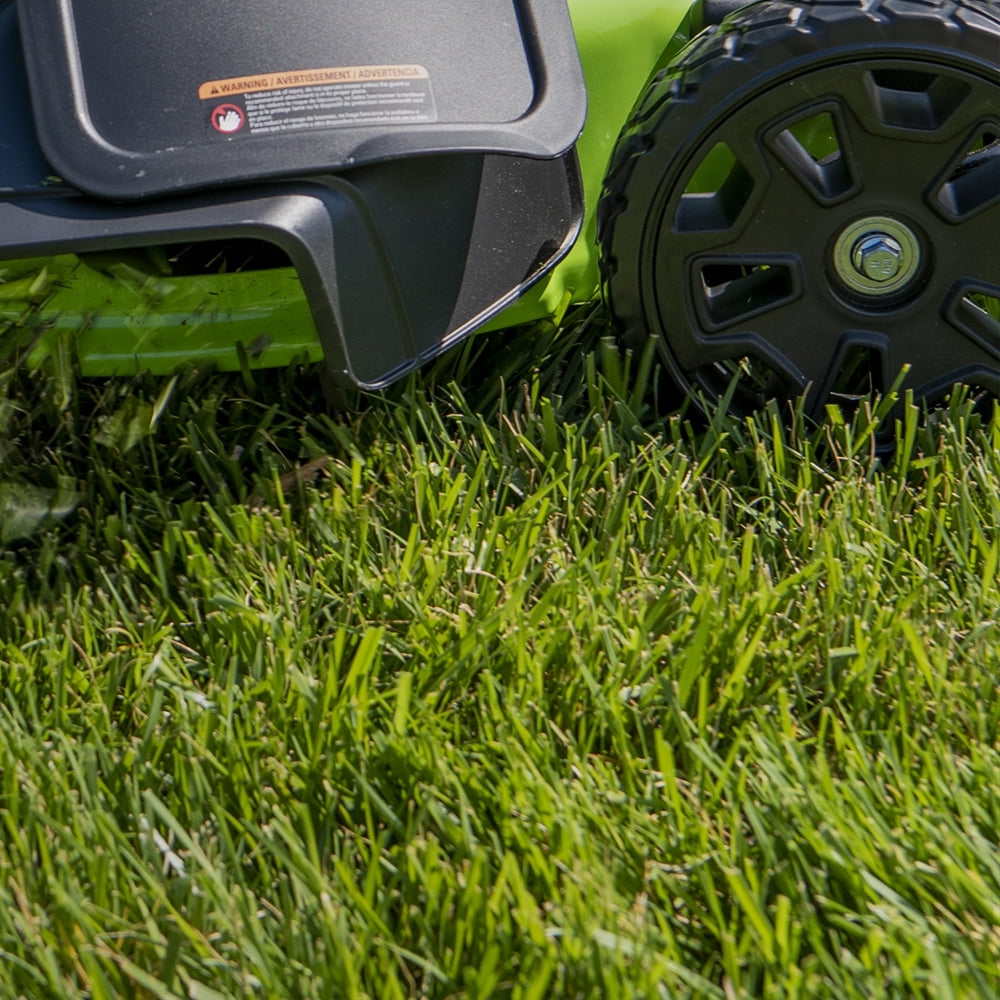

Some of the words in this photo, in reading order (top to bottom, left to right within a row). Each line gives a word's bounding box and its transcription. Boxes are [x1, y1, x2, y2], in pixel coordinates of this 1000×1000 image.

[221, 78, 269, 94] WARNING
[276, 70, 351, 86] AVERTISSEMENT
[358, 67, 419, 79] ADVERTENCIA
